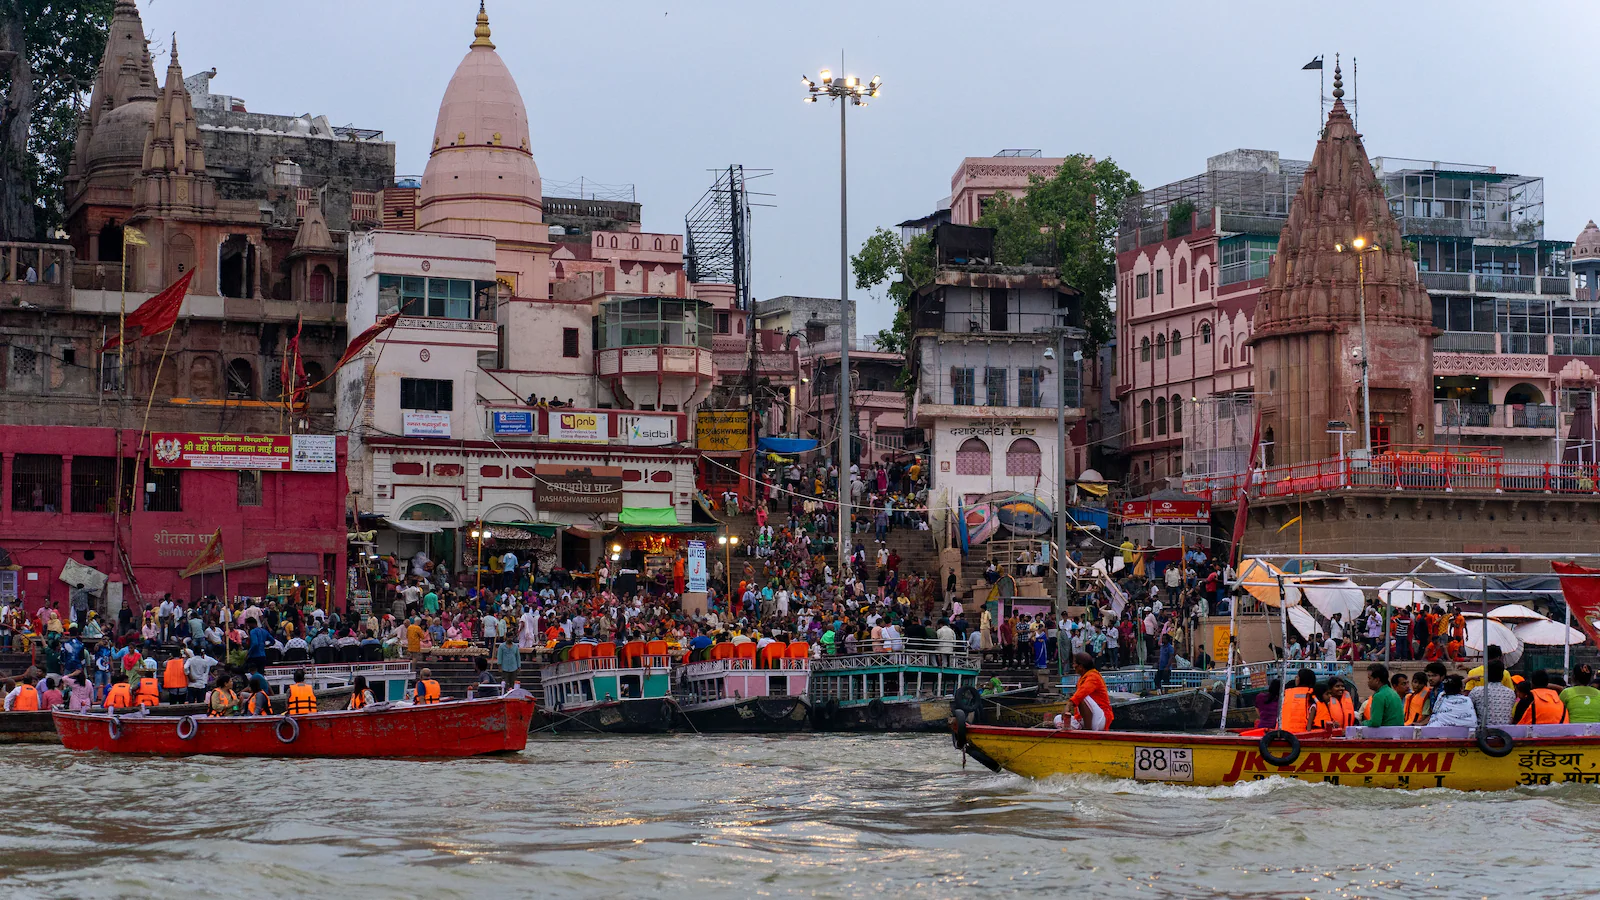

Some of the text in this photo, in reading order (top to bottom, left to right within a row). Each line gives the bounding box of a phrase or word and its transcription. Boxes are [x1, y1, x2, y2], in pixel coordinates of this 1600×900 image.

[576, 416, 595, 428] pnb
[642, 430, 669, 439] sidbi
[950, 427, 1037, 437] दशाश्वमेध घाट
[710, 437, 730, 445] GHAT
[184, 440, 290, 455] श्री बड़ी शीतला माता माई धाम
[594, 483, 613, 494] घाट
[539, 495, 619, 504] DASHASHVAMEDH GHAT
[153, 529, 214, 545] शीतला घा
[157, 549, 193, 557] SHITALA
[697, 549, 705, 558] CEE
[1497, 563, 1516, 573] घाट
[1172, 750, 1186, 759] TS
[1138, 749, 1167, 771] 88
[1171, 762, 1192, 779] (LKO)
[1516, 772, 1554, 786] अब
